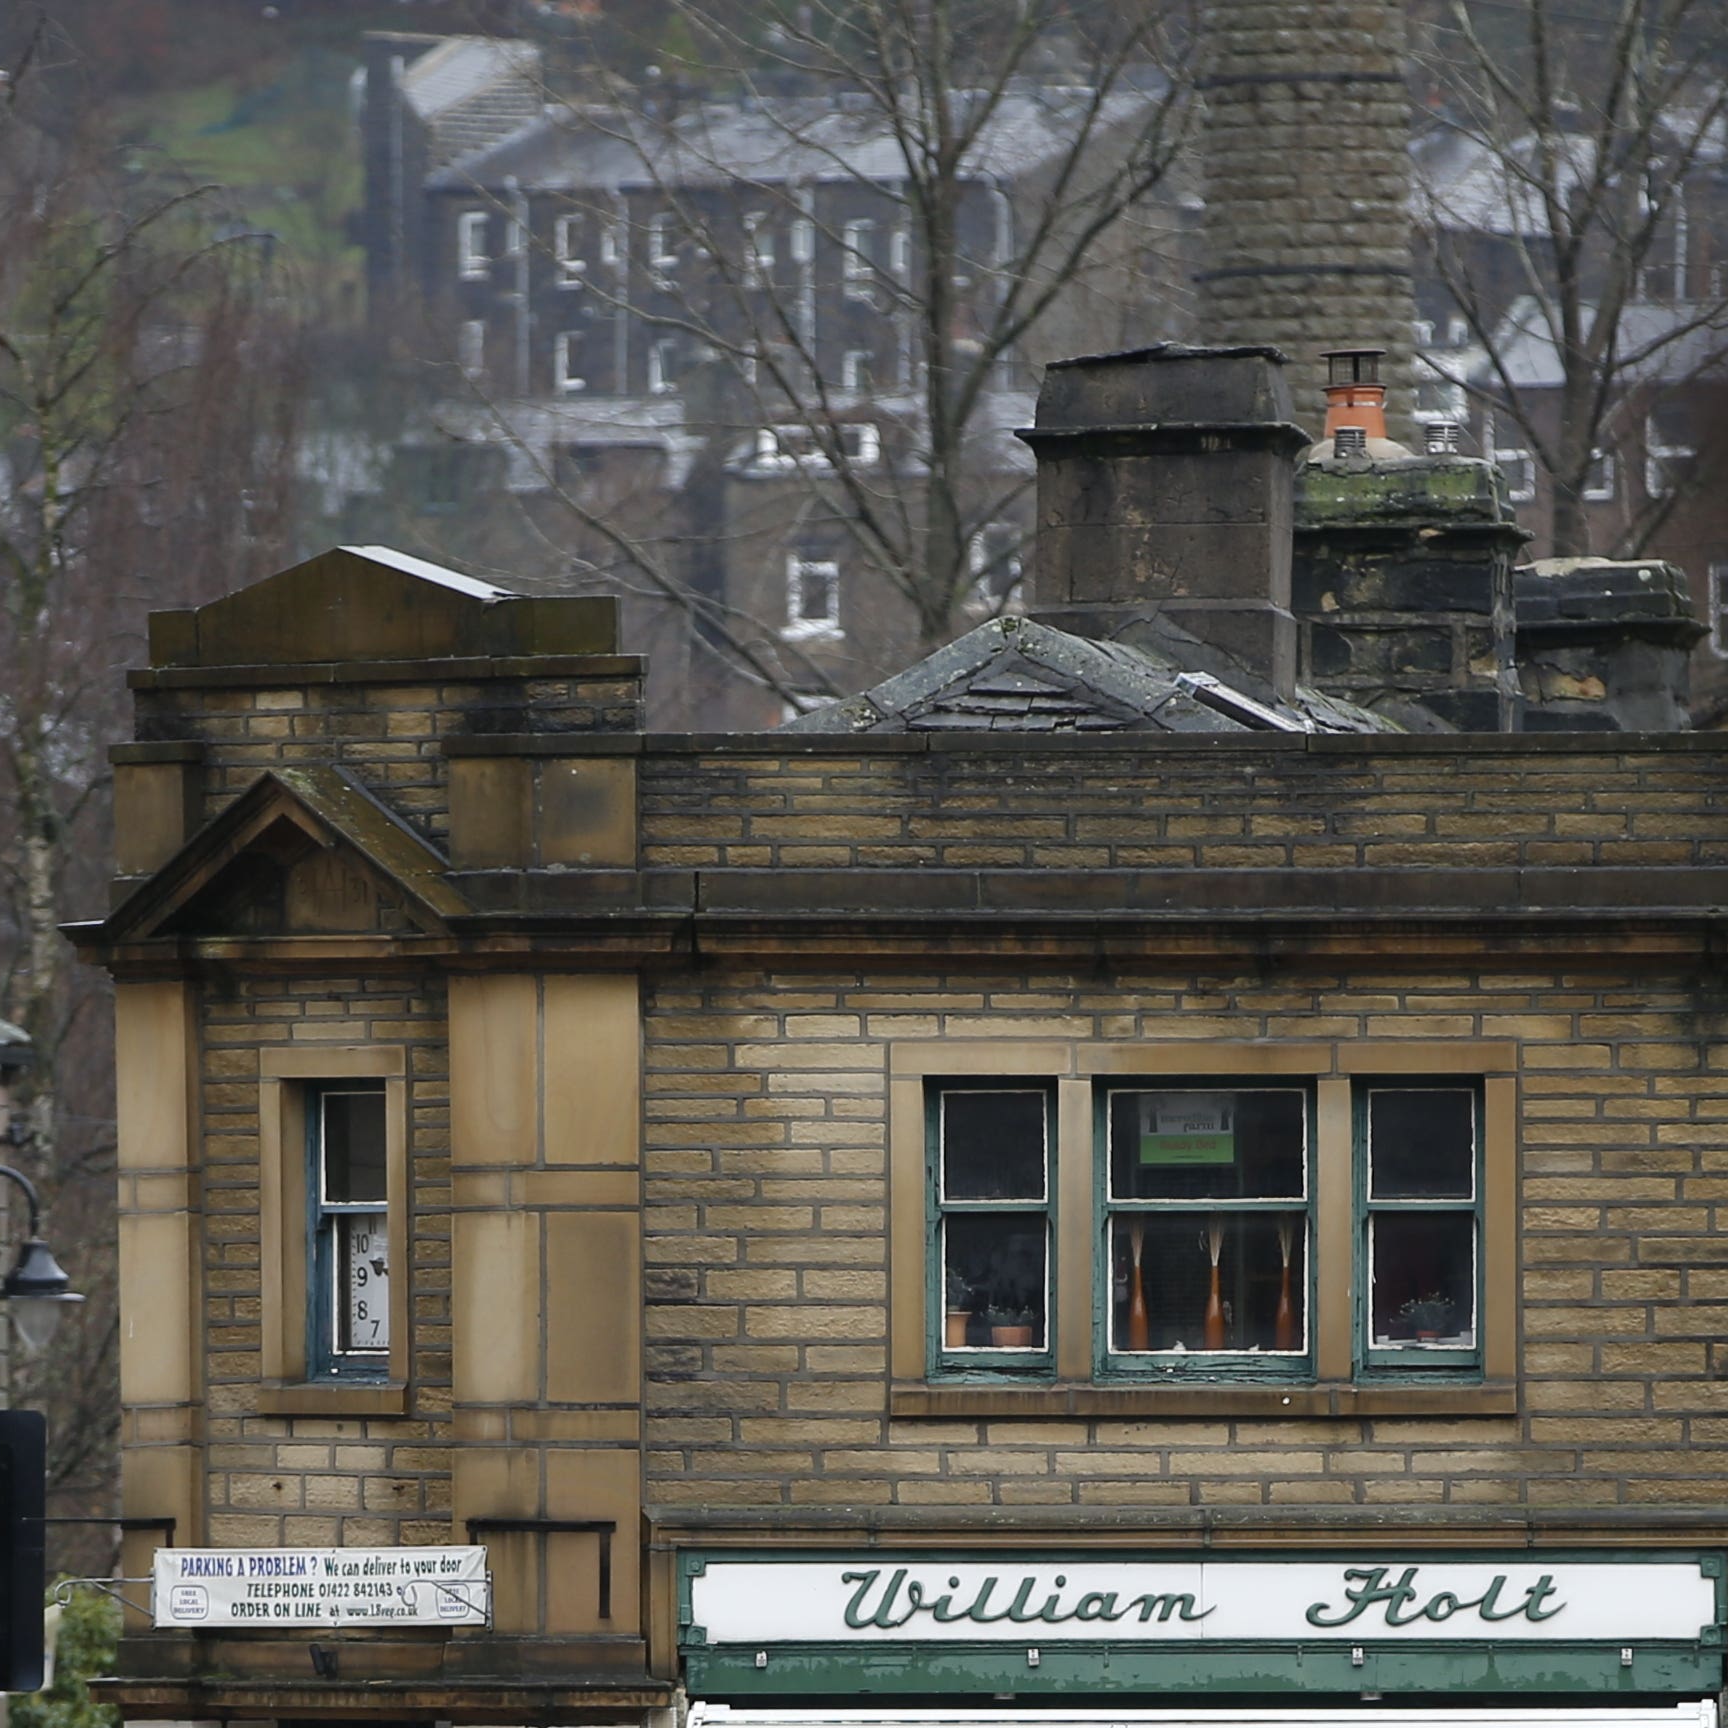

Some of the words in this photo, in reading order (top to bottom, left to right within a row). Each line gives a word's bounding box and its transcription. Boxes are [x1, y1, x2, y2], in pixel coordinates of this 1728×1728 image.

[356, 1234, 369, 1254] 10
[357, 1267, 367, 1287] 9
[357, 1300, 367, 1321] 8
[370, 1320, 380, 1338] 7
[180, 1557, 233, 1578] PARKING
[237, 1557, 245, 1577] A
[249, 1556, 306, 1577] PROBLEM
[310, 1556, 317, 1576] ?
[324, 1557, 339, 1577] We
[342, 1559, 359, 1576] can
[363, 1556, 397, 1576] deliver
[400, 1558, 411, 1575] to
[414, 1559, 437, 1577] your
[440, 1555, 462, 1574] door
[247, 1583, 315, 1598] TELEPHONE
[319, 1583, 350, 1598] 01422
[353, 1583, 393, 1597] 842143
[841, 1568, 1217, 1628] William
[1305, 1567, 1568, 1627] Holt
[231, 1603, 270, 1617] ORDER
[274, 1603, 290, 1617] ON
[294, 1602, 321, 1617] LINE
[329, 1604, 340, 1617] at
